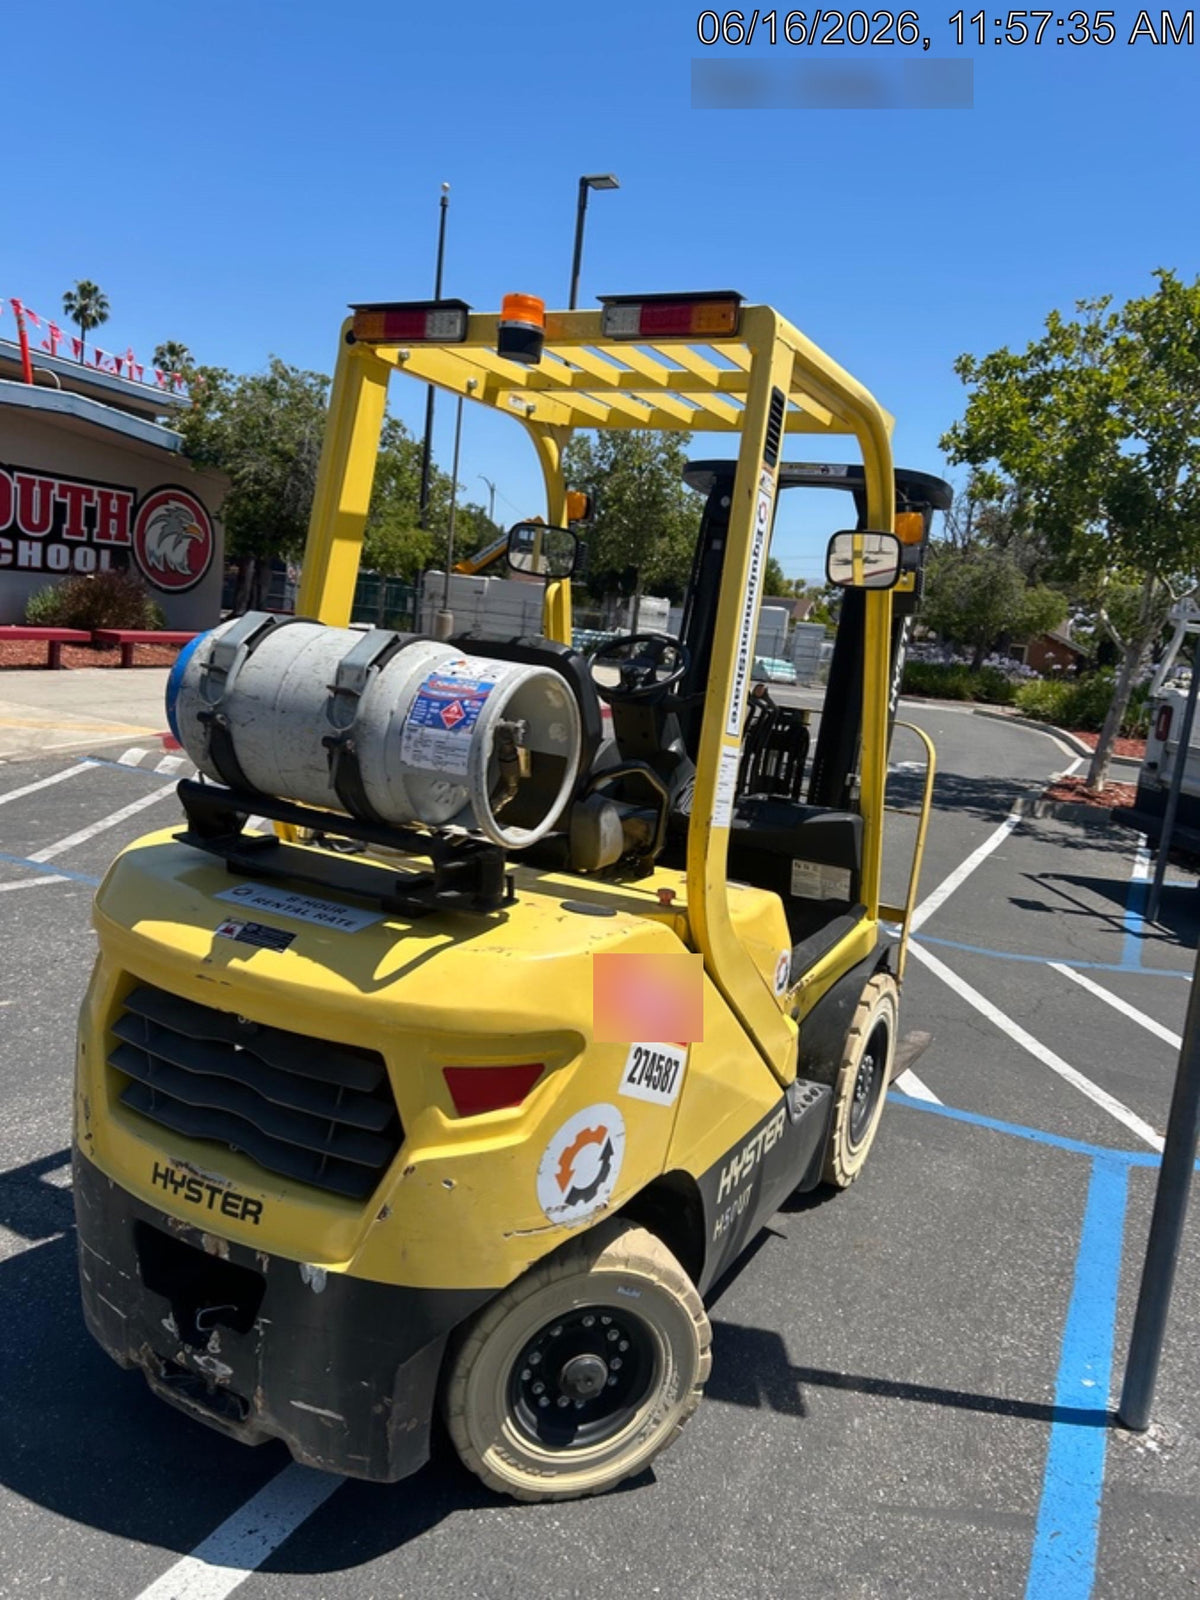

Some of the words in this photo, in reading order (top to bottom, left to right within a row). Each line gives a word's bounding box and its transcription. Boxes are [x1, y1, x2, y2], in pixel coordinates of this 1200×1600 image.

[251, 897, 310, 916] RENTAL
[312, 913, 358, 928] RATE
[301, 900, 348, 915] HOUR
[626, 1046, 680, 1094] 274587
[716, 1107, 785, 1205] HYSTER
[151, 1162, 263, 1225] HYSTER
